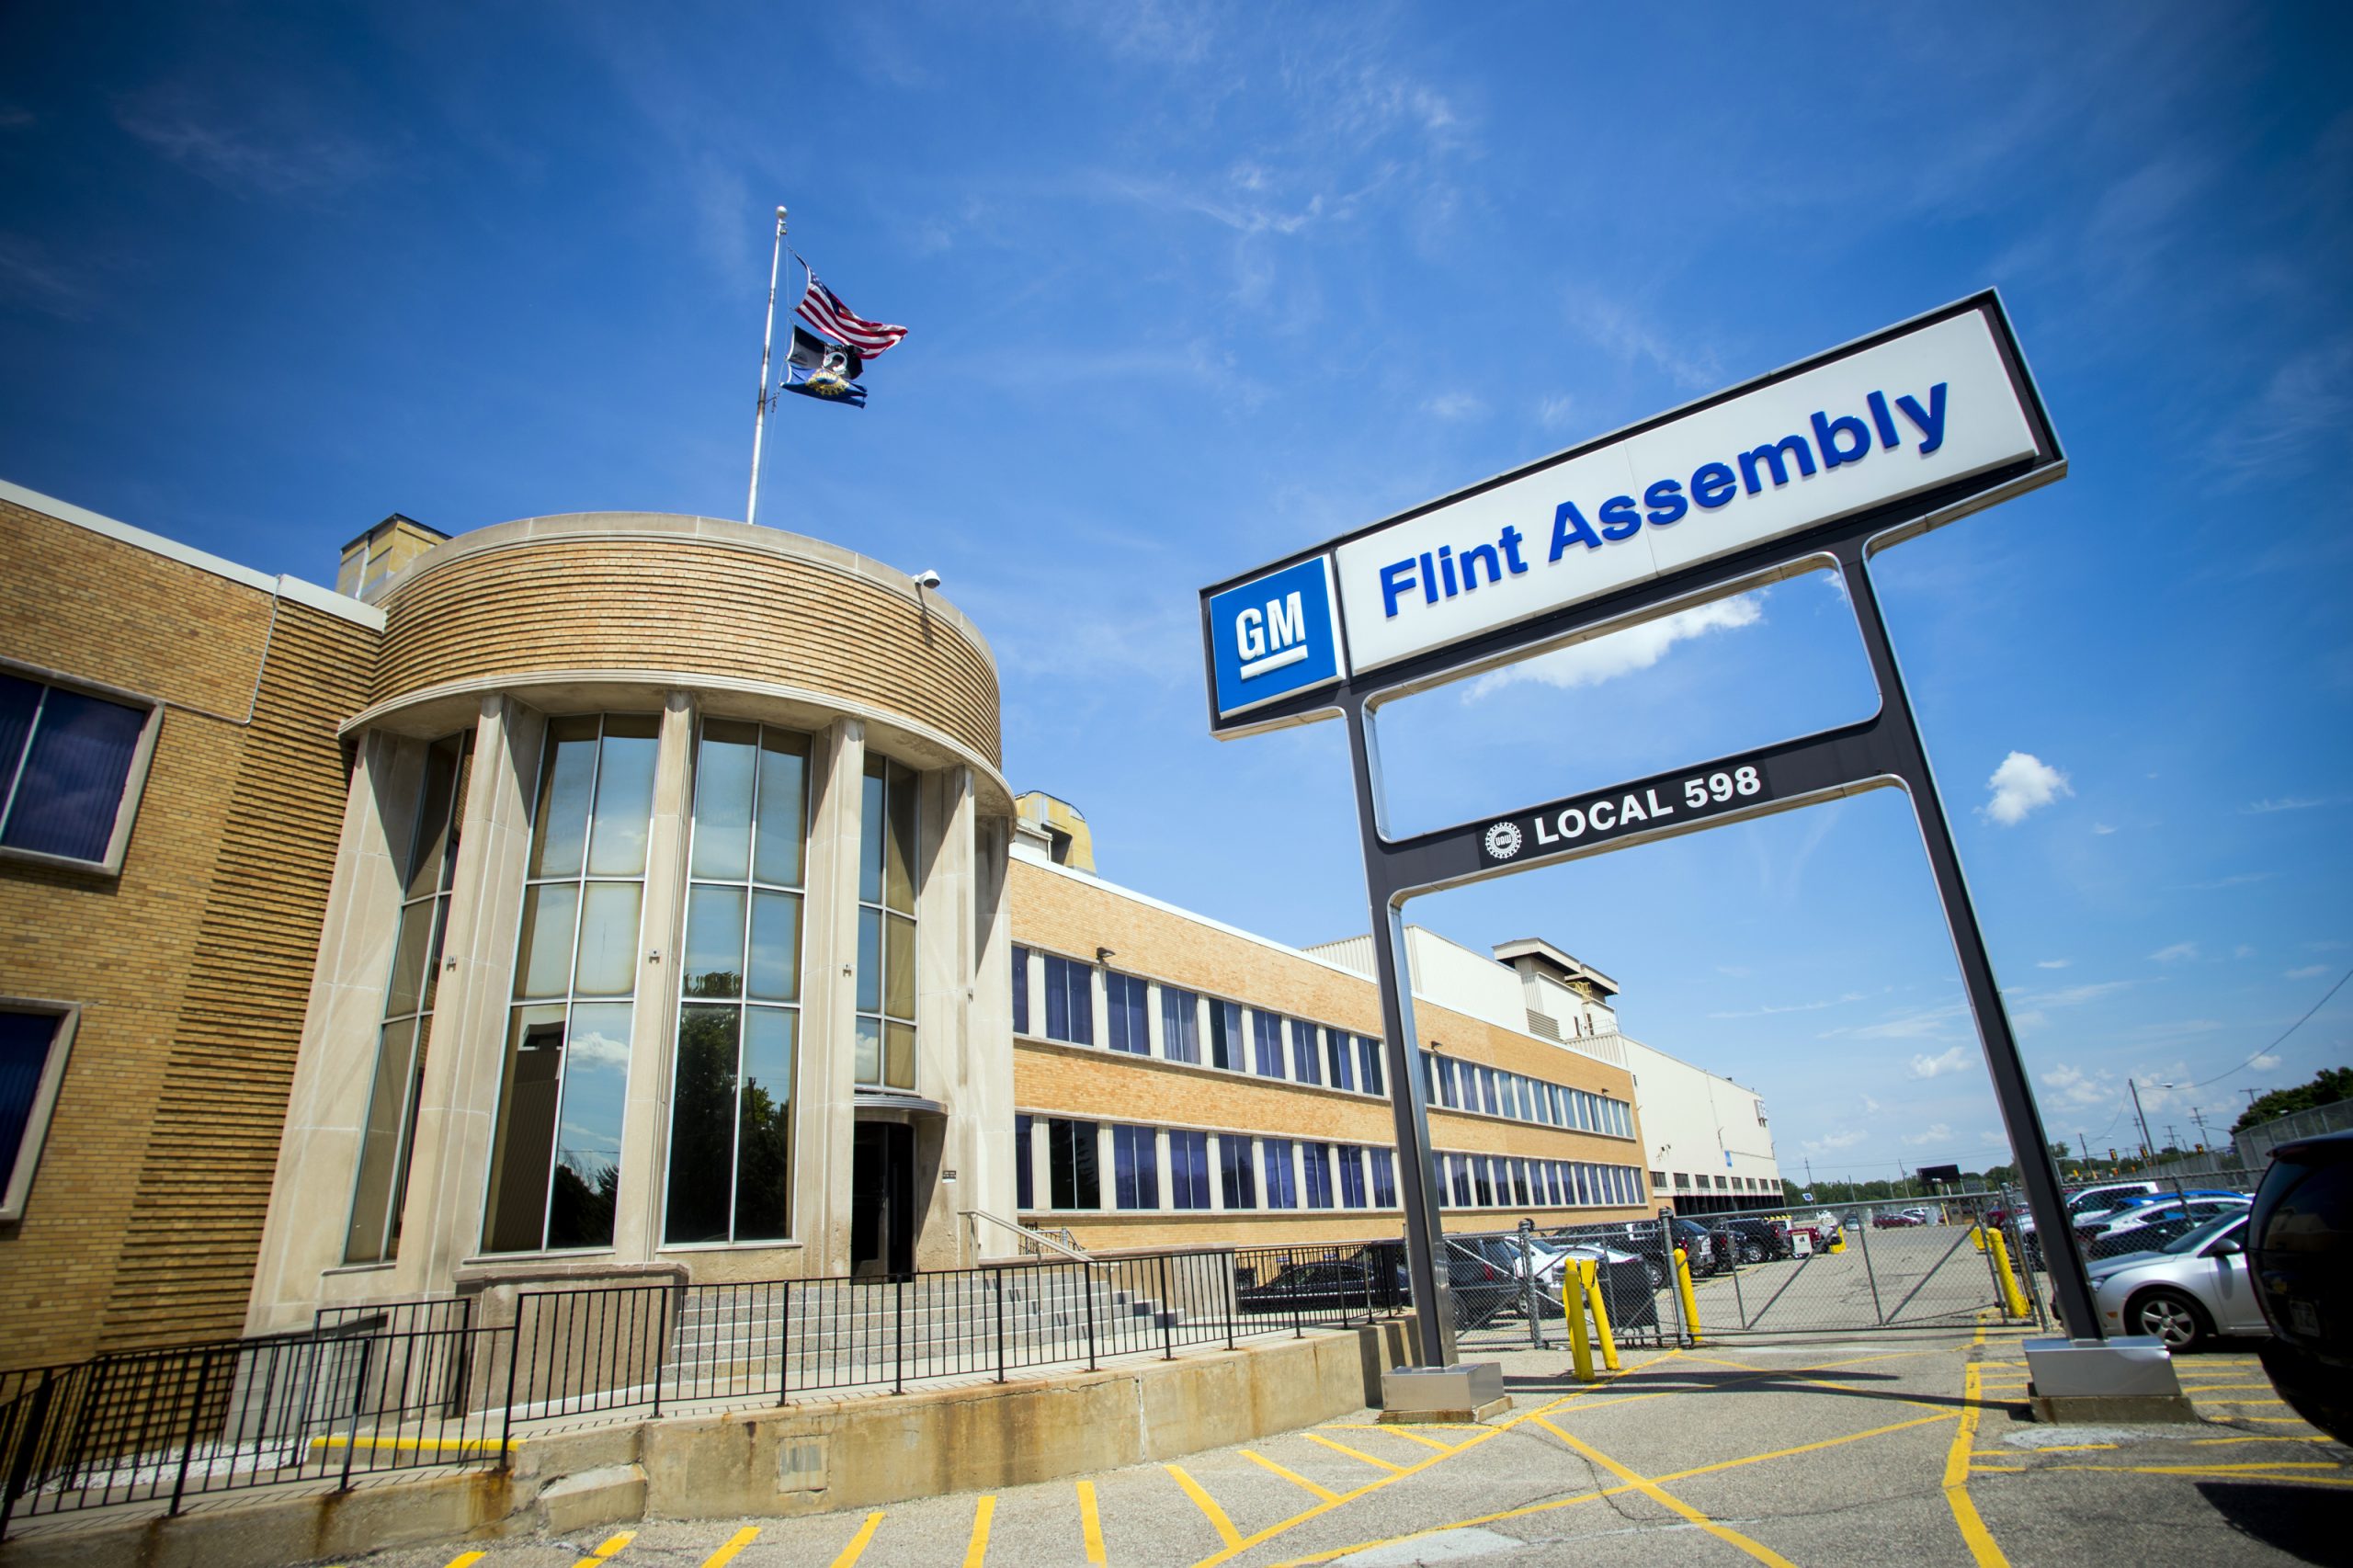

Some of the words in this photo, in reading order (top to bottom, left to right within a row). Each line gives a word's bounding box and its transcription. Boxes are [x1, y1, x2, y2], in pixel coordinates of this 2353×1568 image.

[1380, 525, 1529, 618] Flint
[1549, 381, 1948, 562] Assembly
[1235, 591, 1306, 660] GM
[1495, 834, 1512, 846] UAW
[1534, 789, 1674, 845] LOCAL
[1684, 766, 1761, 808] 598
